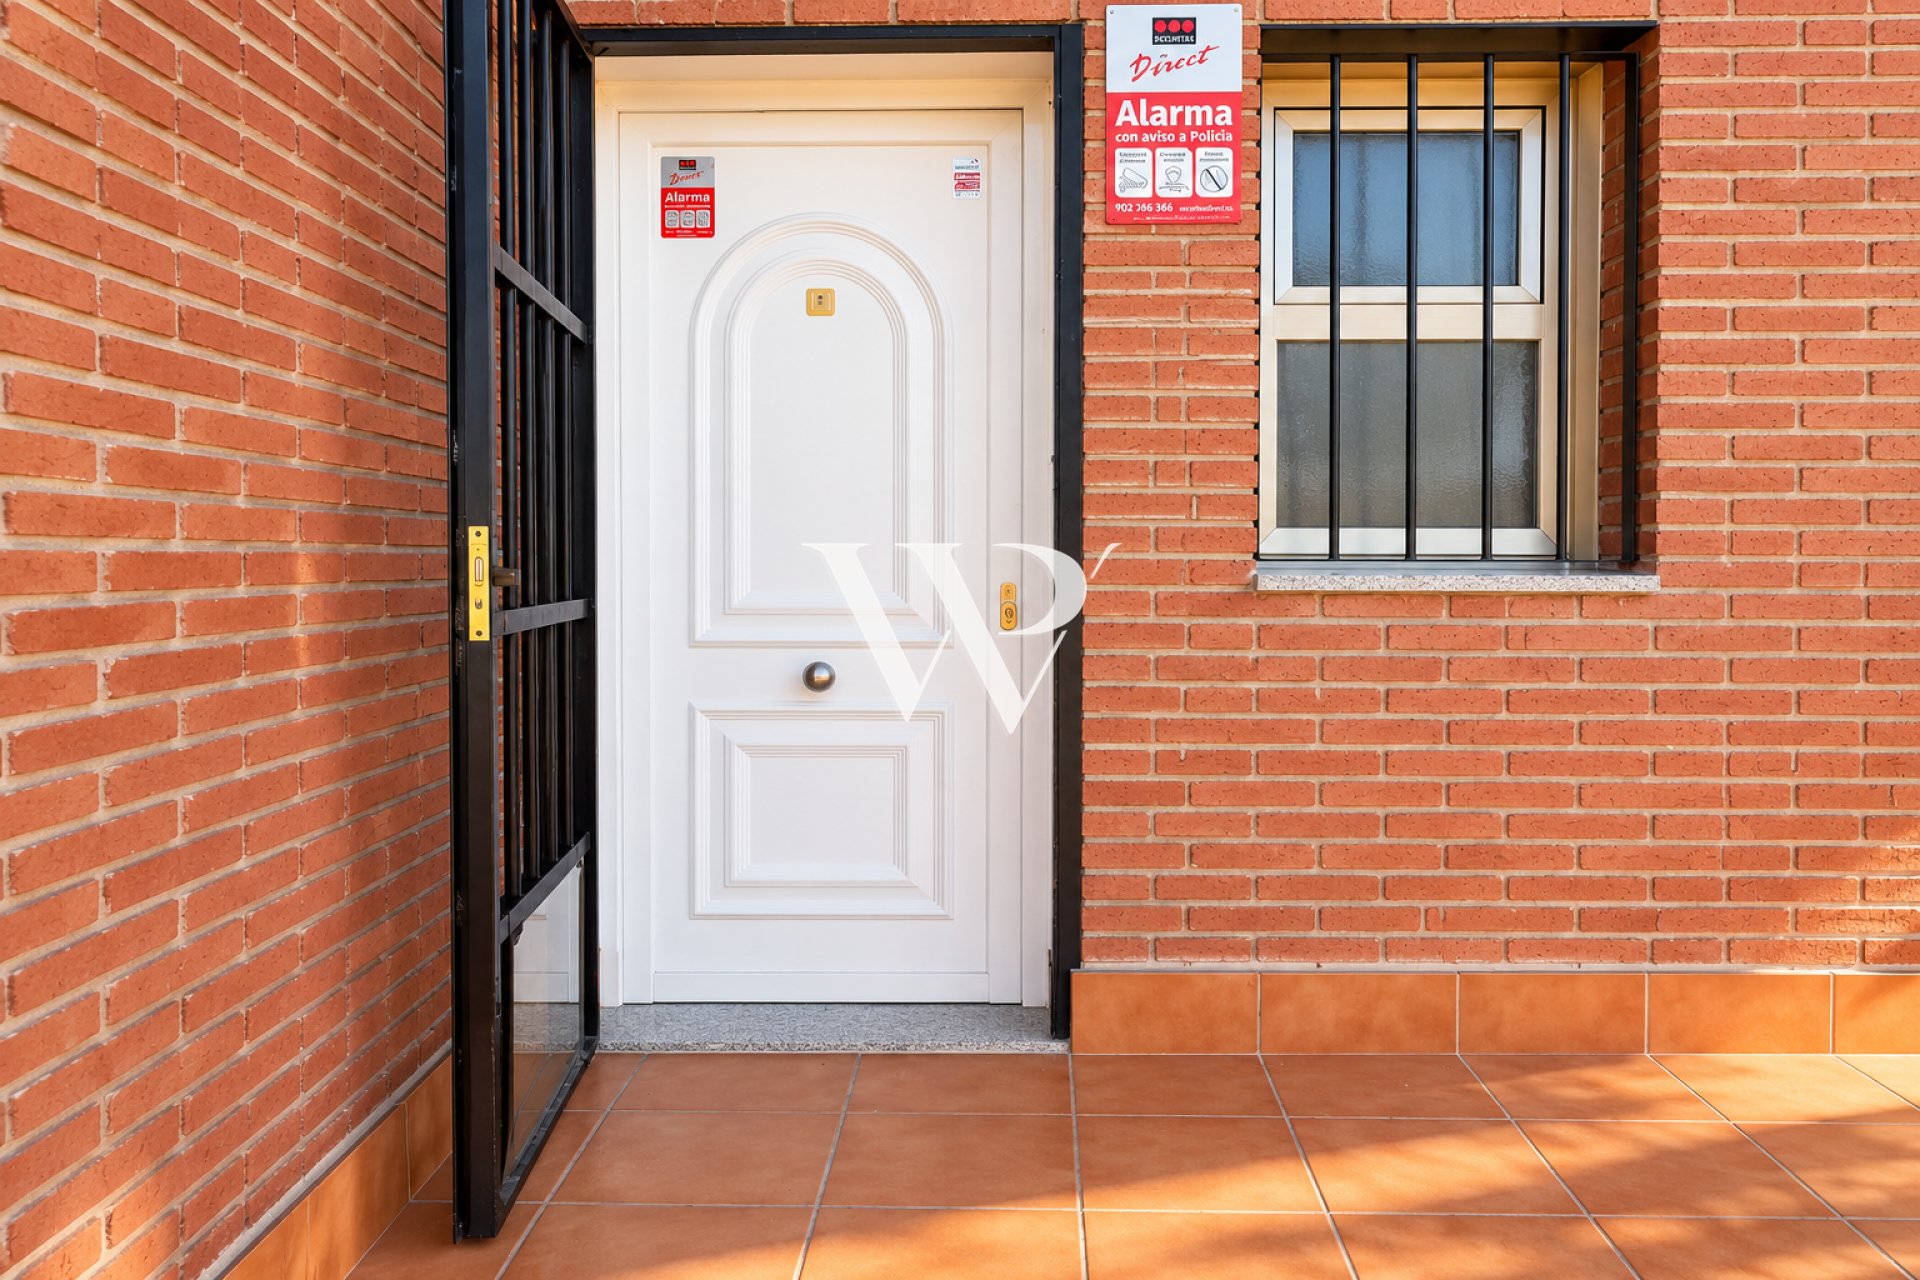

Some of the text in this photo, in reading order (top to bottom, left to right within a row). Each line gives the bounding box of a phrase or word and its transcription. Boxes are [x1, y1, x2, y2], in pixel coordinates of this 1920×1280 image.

[1115, 98, 1233, 126] Alarma
[1115, 133, 1138, 142] con
[1142, 130, 1175, 142] aviso
[1179, 133, 1186, 142] a
[665, 191, 711, 202] Alarma
[1115, 203, 1133, 212] 902
